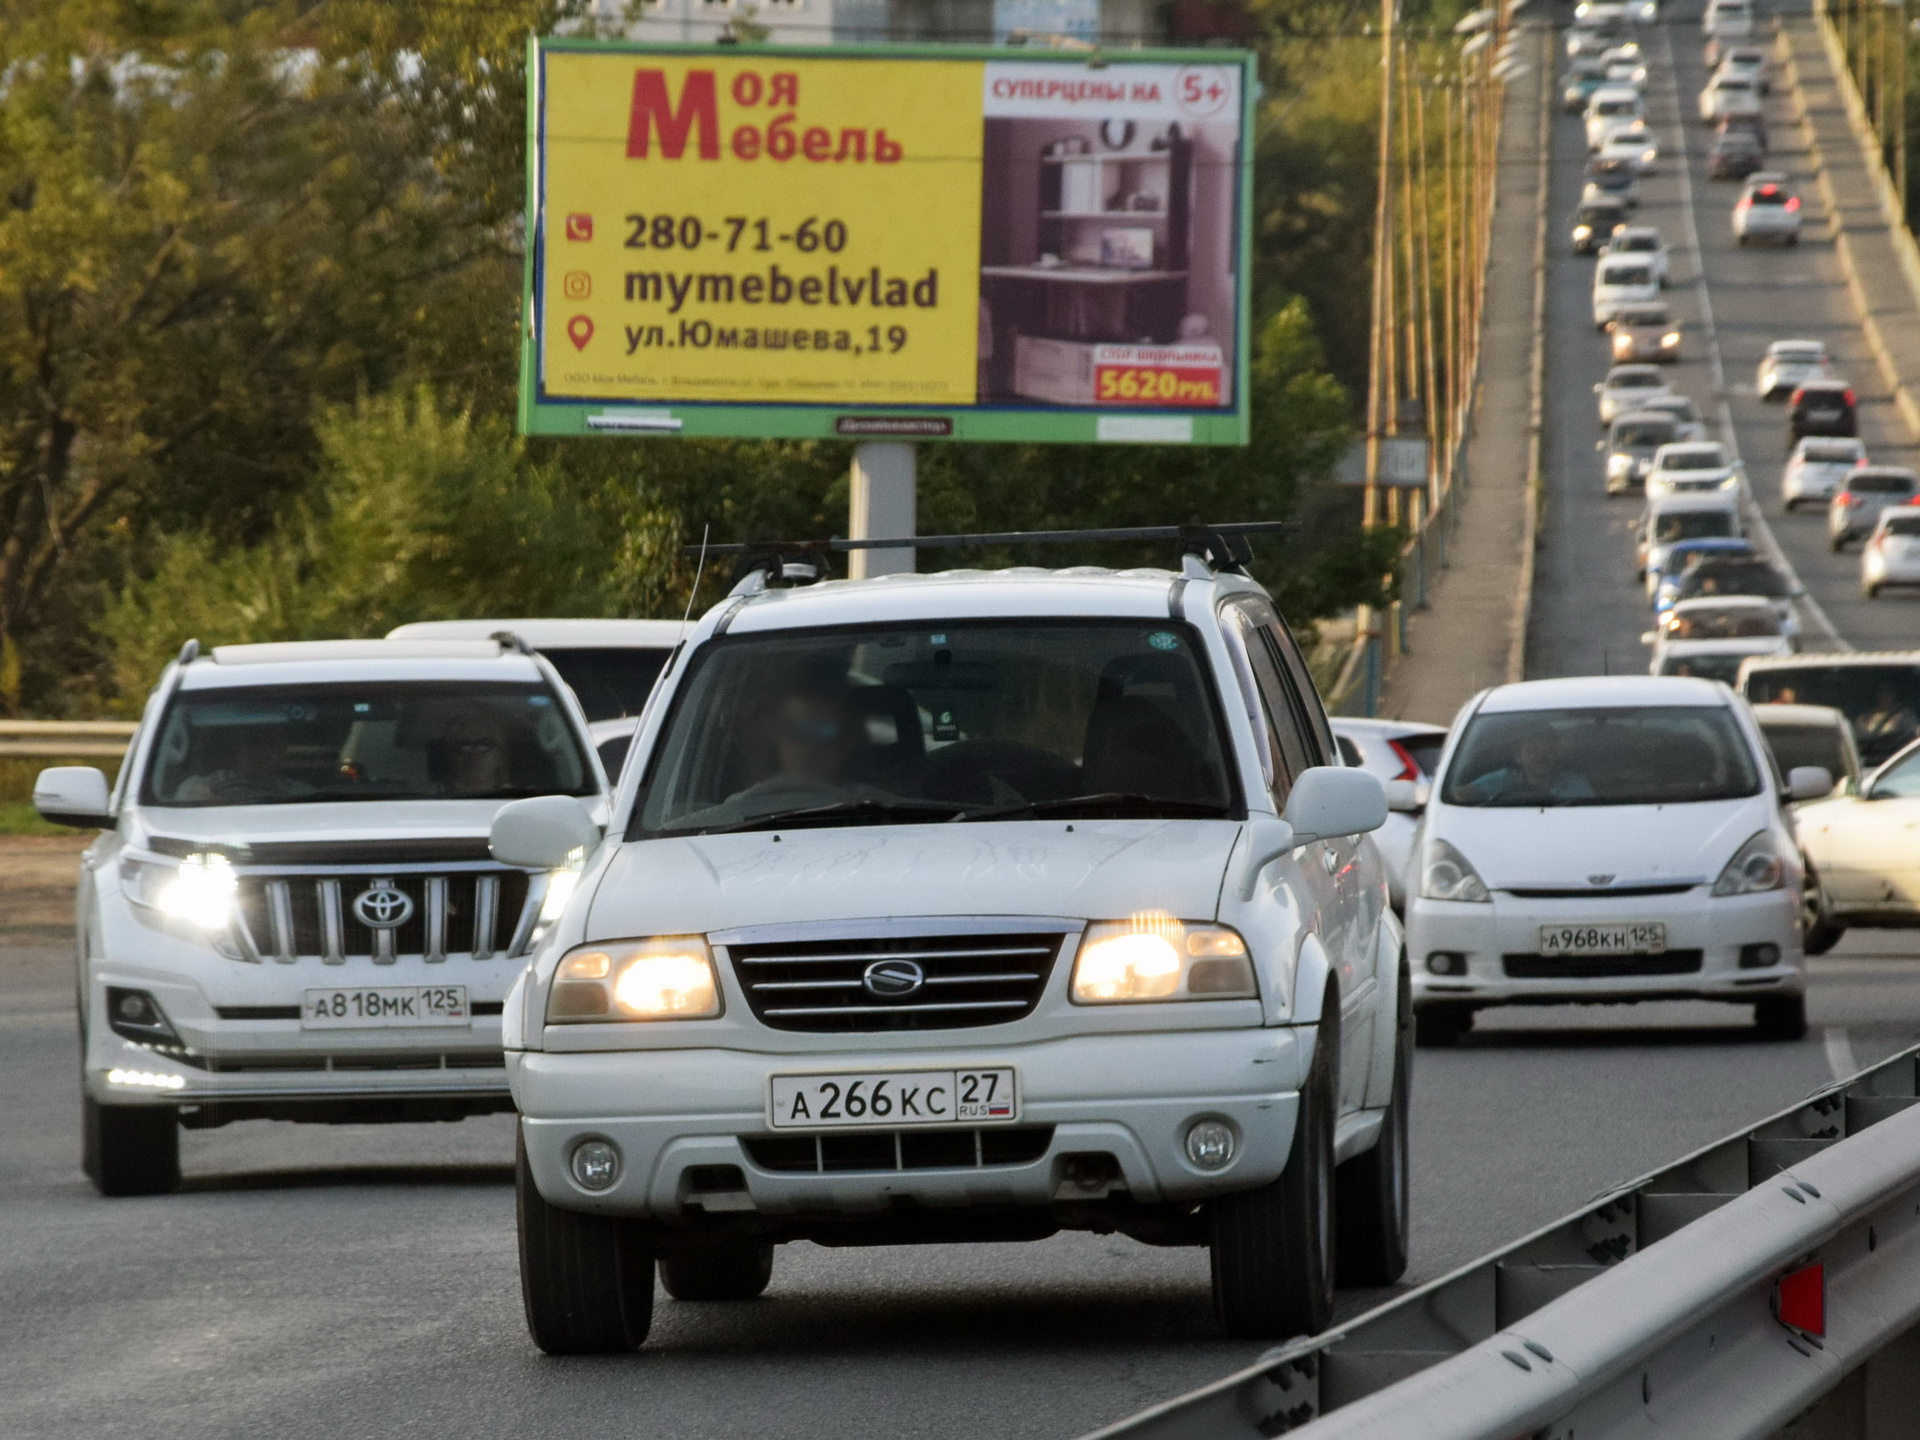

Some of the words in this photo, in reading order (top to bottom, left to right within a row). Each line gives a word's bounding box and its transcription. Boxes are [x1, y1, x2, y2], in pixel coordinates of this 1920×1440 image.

[992, 77, 1125, 104] СУПЕРЦЕНЫ
[1131, 82, 1162, 102] НА
[1183, 74, 1224, 102] 5+
[624, 214, 848, 252] 280-71-60
[624, 266, 938, 313] mymebelvlad
[1630, 926, 1658, 942] 125
[314, 992, 415, 1017] А818МК
[421, 988, 459, 1008] 125
[791, 1080, 946, 1119] А266КС
[960, 1073, 999, 1103] 27
[959, 1104, 988, 1116] RUS
